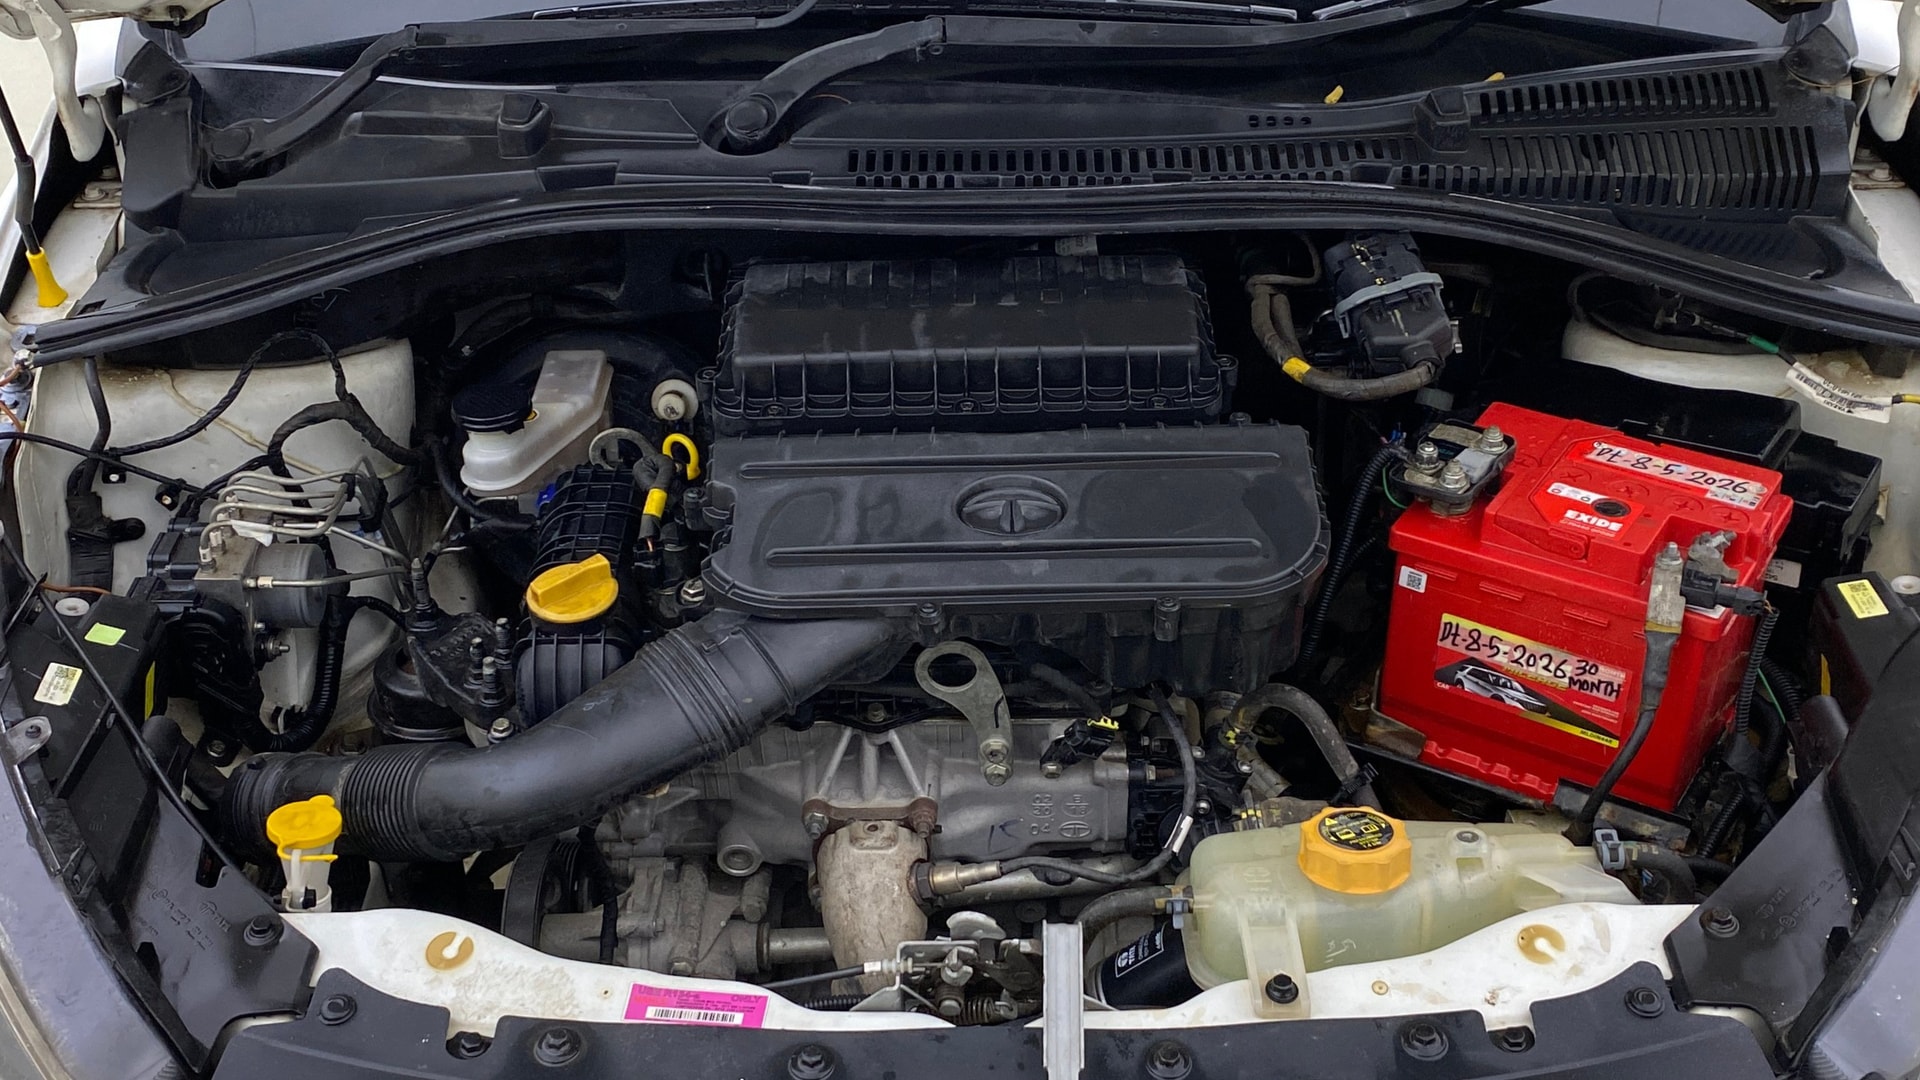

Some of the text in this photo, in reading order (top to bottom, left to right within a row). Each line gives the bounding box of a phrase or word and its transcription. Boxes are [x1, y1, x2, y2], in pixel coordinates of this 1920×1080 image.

[1563, 509, 1623, 532] EXIDE
[1575, 659, 1599, 676] 30
[1567, 674, 1623, 699] MONTH
